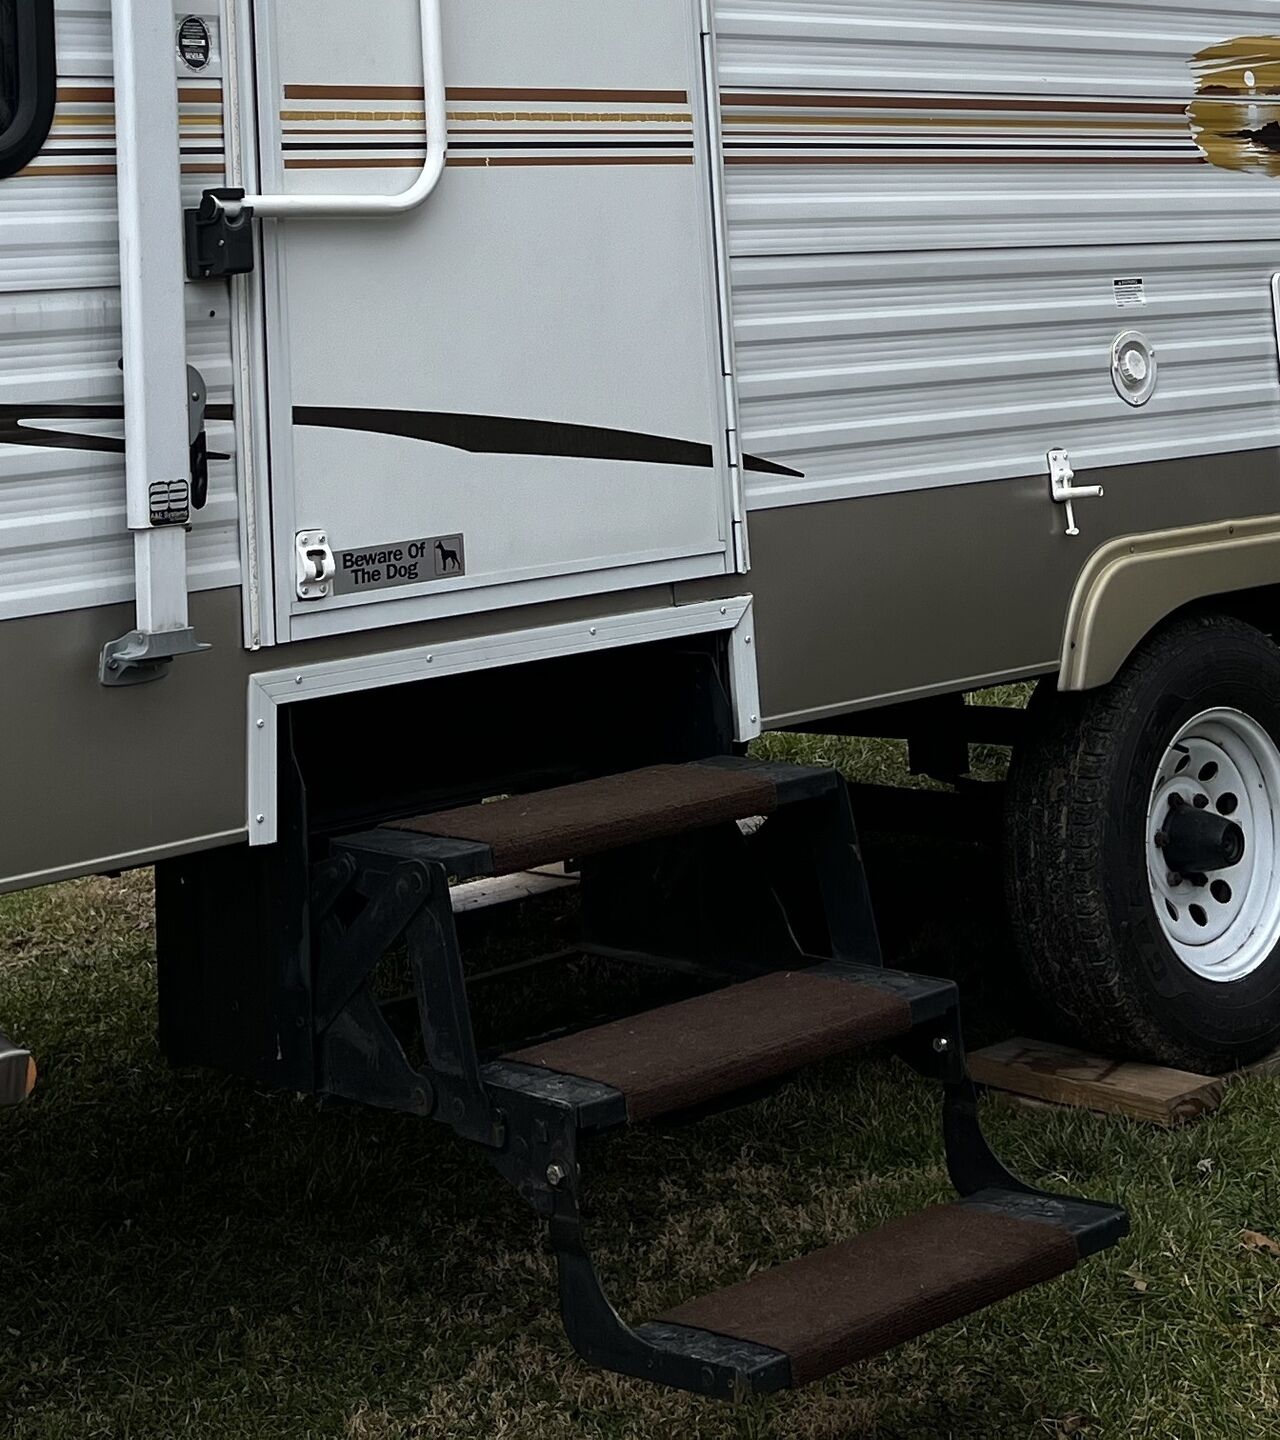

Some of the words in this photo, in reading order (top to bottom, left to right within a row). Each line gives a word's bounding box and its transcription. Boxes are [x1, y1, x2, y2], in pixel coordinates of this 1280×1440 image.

[342, 548, 403, 570] Beware
[408, 541, 426, 559] Of
[351, 567, 381, 585] The
[386, 561, 419, 580] Dog
